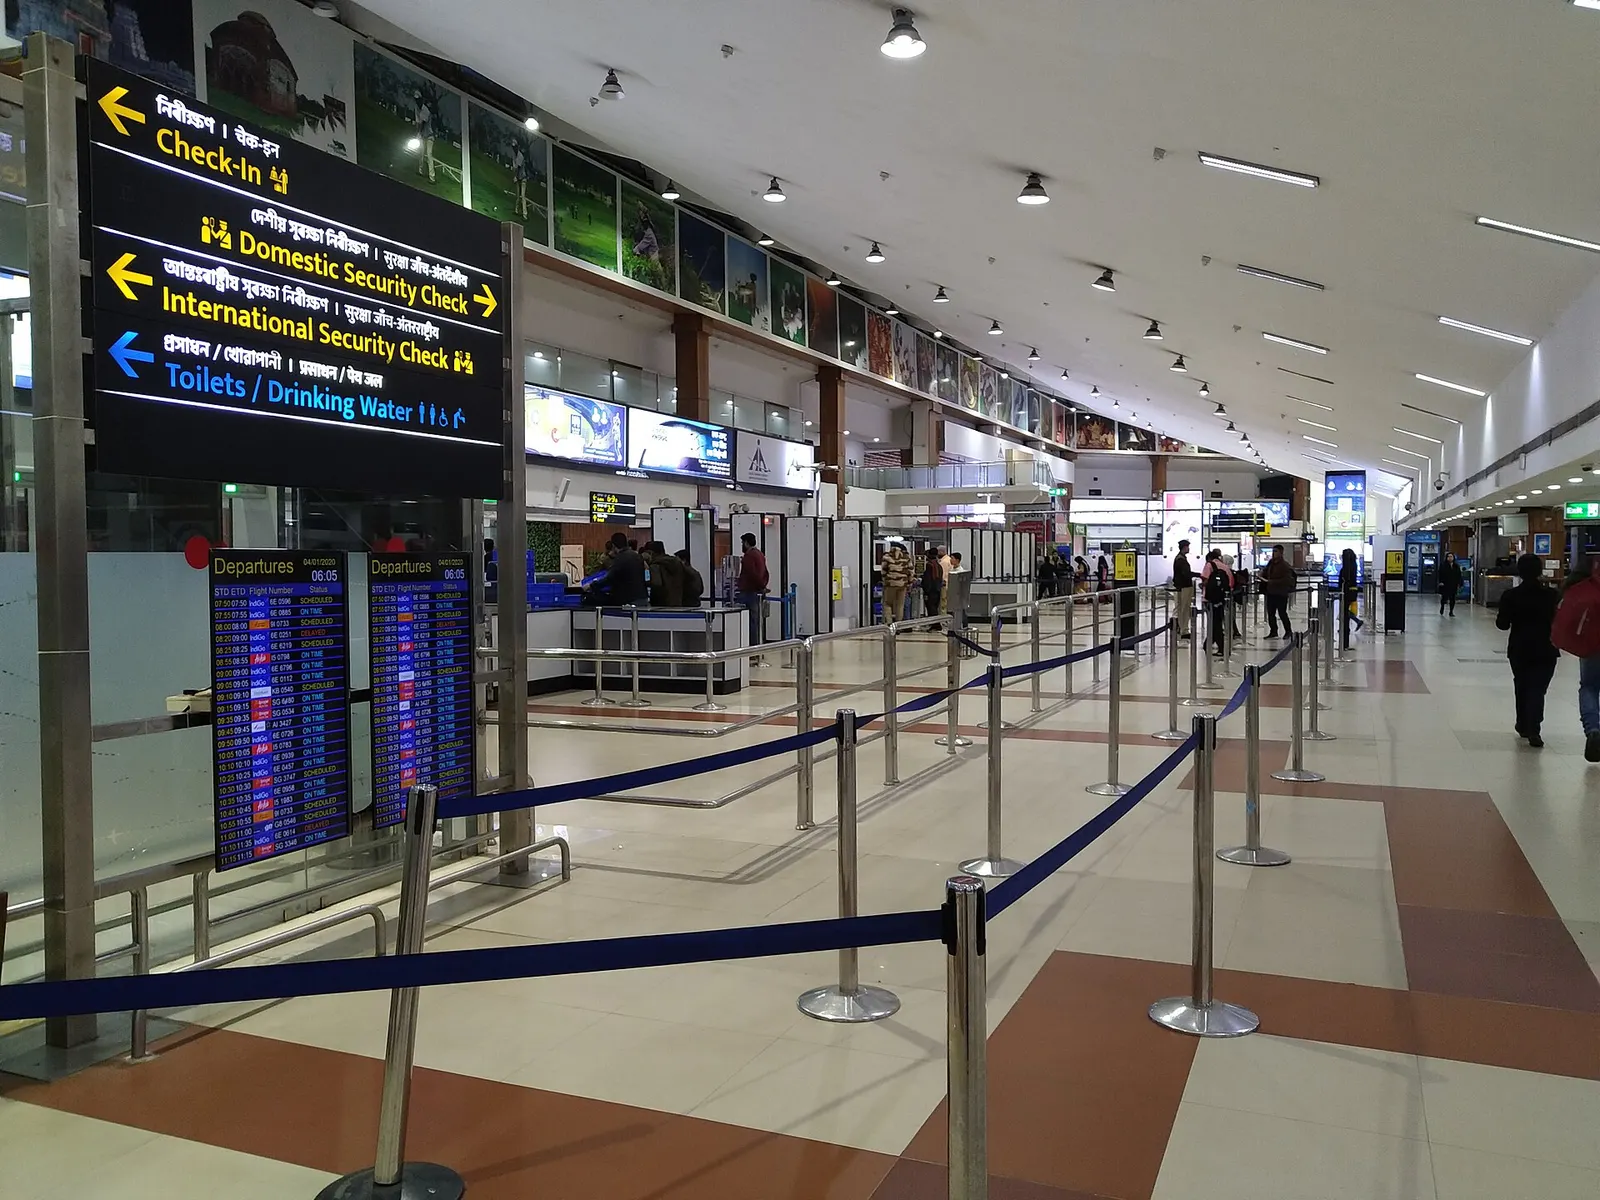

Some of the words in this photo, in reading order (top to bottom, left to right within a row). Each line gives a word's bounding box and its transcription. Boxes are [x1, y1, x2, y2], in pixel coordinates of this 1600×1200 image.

[233, 124, 280, 158] चेक-इन
[156, 128, 260, 185] Check-In
[382, 250, 409, 269] सुरक्षा
[240, 230, 338, 279] Domestic
[343, 262, 417, 306] Security
[421, 284, 468, 314] Check
[343, 303, 372, 324] सुरक्षा
[163, 286, 313, 340] International
[318, 322, 395, 363] Security
[399, 340, 448, 369] Check
[298, 359, 338, 380] प्रसाधन
[363, 372, 383, 388] जल
[164, 362, 245, 397] Toilets
[251, 374, 261, 402] /
[268, 379, 354, 419] Drinking
[359, 394, 412, 421] Water
[214, 558, 294, 578] Departures
[303, 558, 336, 566] 04/01/2020
[372, 560, 432, 576] Departures
[312, 570, 338, 581] 06:05
[445, 569, 465, 579] 06:05
[215, 588, 229, 596] STD
[231, 588, 245, 596] ETD
[250, 587, 268, 596] Flight
[269, 586, 294, 594] Number
[310, 585, 328, 593] Status
[372, 585, 383, 593] STD
[300, 596, 333, 604] SCHEDULED
[300, 617, 333, 625] SCHEDULED
[232, 633, 247, 641] 09:00
[301, 628, 325, 636] DELAYED
[232, 645, 247, 653] 08:25
[301, 638, 333, 647] SCHEDULED
[232, 656, 248, 664] 08:55
[232, 668, 248, 676] 09:00
[310, 660, 323, 668] TIME
[233, 679, 248, 687] 09:05
[233, 690, 248, 699] 09:10
[302, 680, 334, 690] SCHEDULED
[233, 702, 249, 710] 09:15
[311, 692, 324, 700] TIME
[233, 713, 249, 722] 09:35
[311, 703, 324, 711] TIME
[234, 724, 249, 733] 09:45
[302, 715, 310, 723] ON
[311, 713, 324, 721] TIME
[234, 736, 250, 745] 09:50
[302, 726, 311, 734] ON
[312, 724, 324, 732] TIME
[234, 747, 250, 756] 10:05
[303, 737, 311, 745] ON
[312, 735, 324, 743] TIME
[235, 759, 250, 768] 10:10
[312, 745, 325, 754] TIME
[235, 770, 250, 780] 10:25
[312, 756, 325, 765] TIME
[235, 782, 251, 791] 10:30
[304, 765, 336, 777] SCHEDULED
[235, 793, 251, 803] 10:35
[304, 780, 312, 788] ON
[313, 777, 325, 786] TIME
[236, 804, 251, 814] 10:45
[304, 791, 312, 799] ON
[313, 788, 325, 797] TIME
[236, 816, 251, 826] 10:55
[304, 796, 336, 810] SCHEDULED
[236, 827, 252, 838] 11:00
[304, 807, 336, 821] SCHEDULED
[236, 839, 252, 849] 11:35
[305, 820, 329, 832] DELAYED
[237, 850, 252, 861] 11:15
[305, 834, 313, 843] ON
[314, 831, 326, 840] TIME
